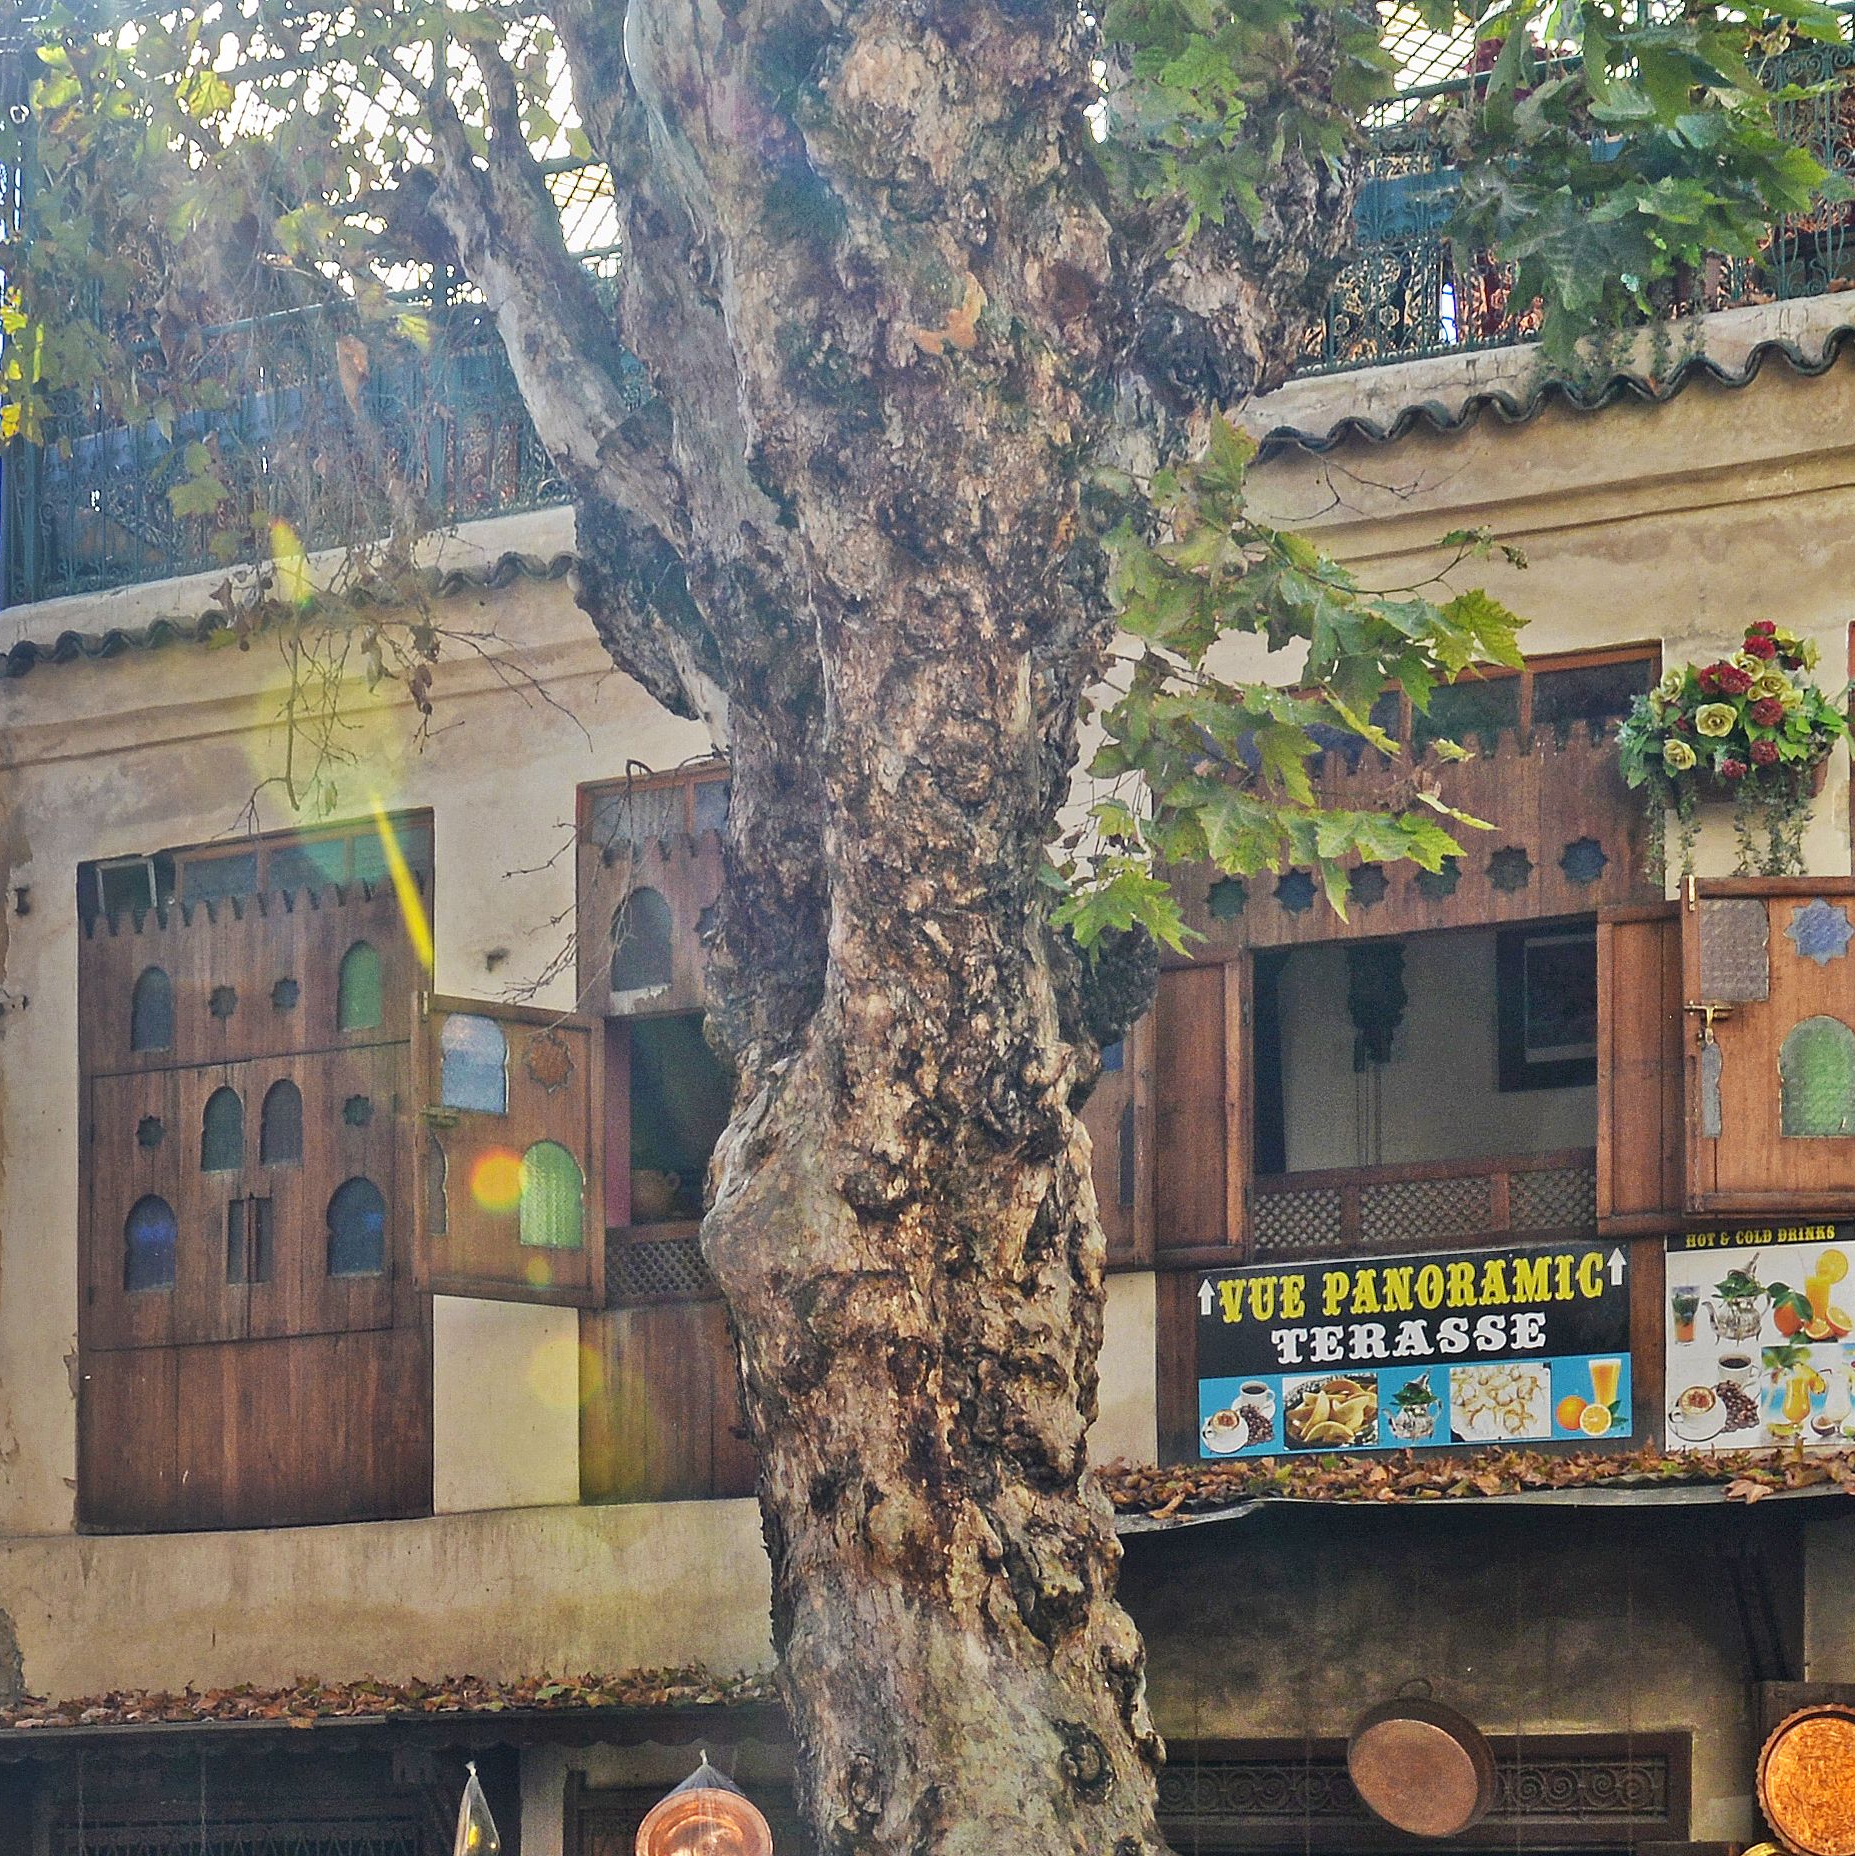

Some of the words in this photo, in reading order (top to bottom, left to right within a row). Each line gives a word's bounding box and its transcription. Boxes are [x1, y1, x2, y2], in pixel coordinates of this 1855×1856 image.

[1685, 1231, 1716, 1247] HOT
[1720, 1232, 1730, 1245] &
[1735, 1229, 1773, 1245] COLD
[1777, 1225, 1836, 1243] DRINKS
[1218, 1273, 1304, 1323] VUE
[1322, 1251, 1603, 1316] PANORAMIC
[1271, 1311, 1546, 1364] TERASSE
